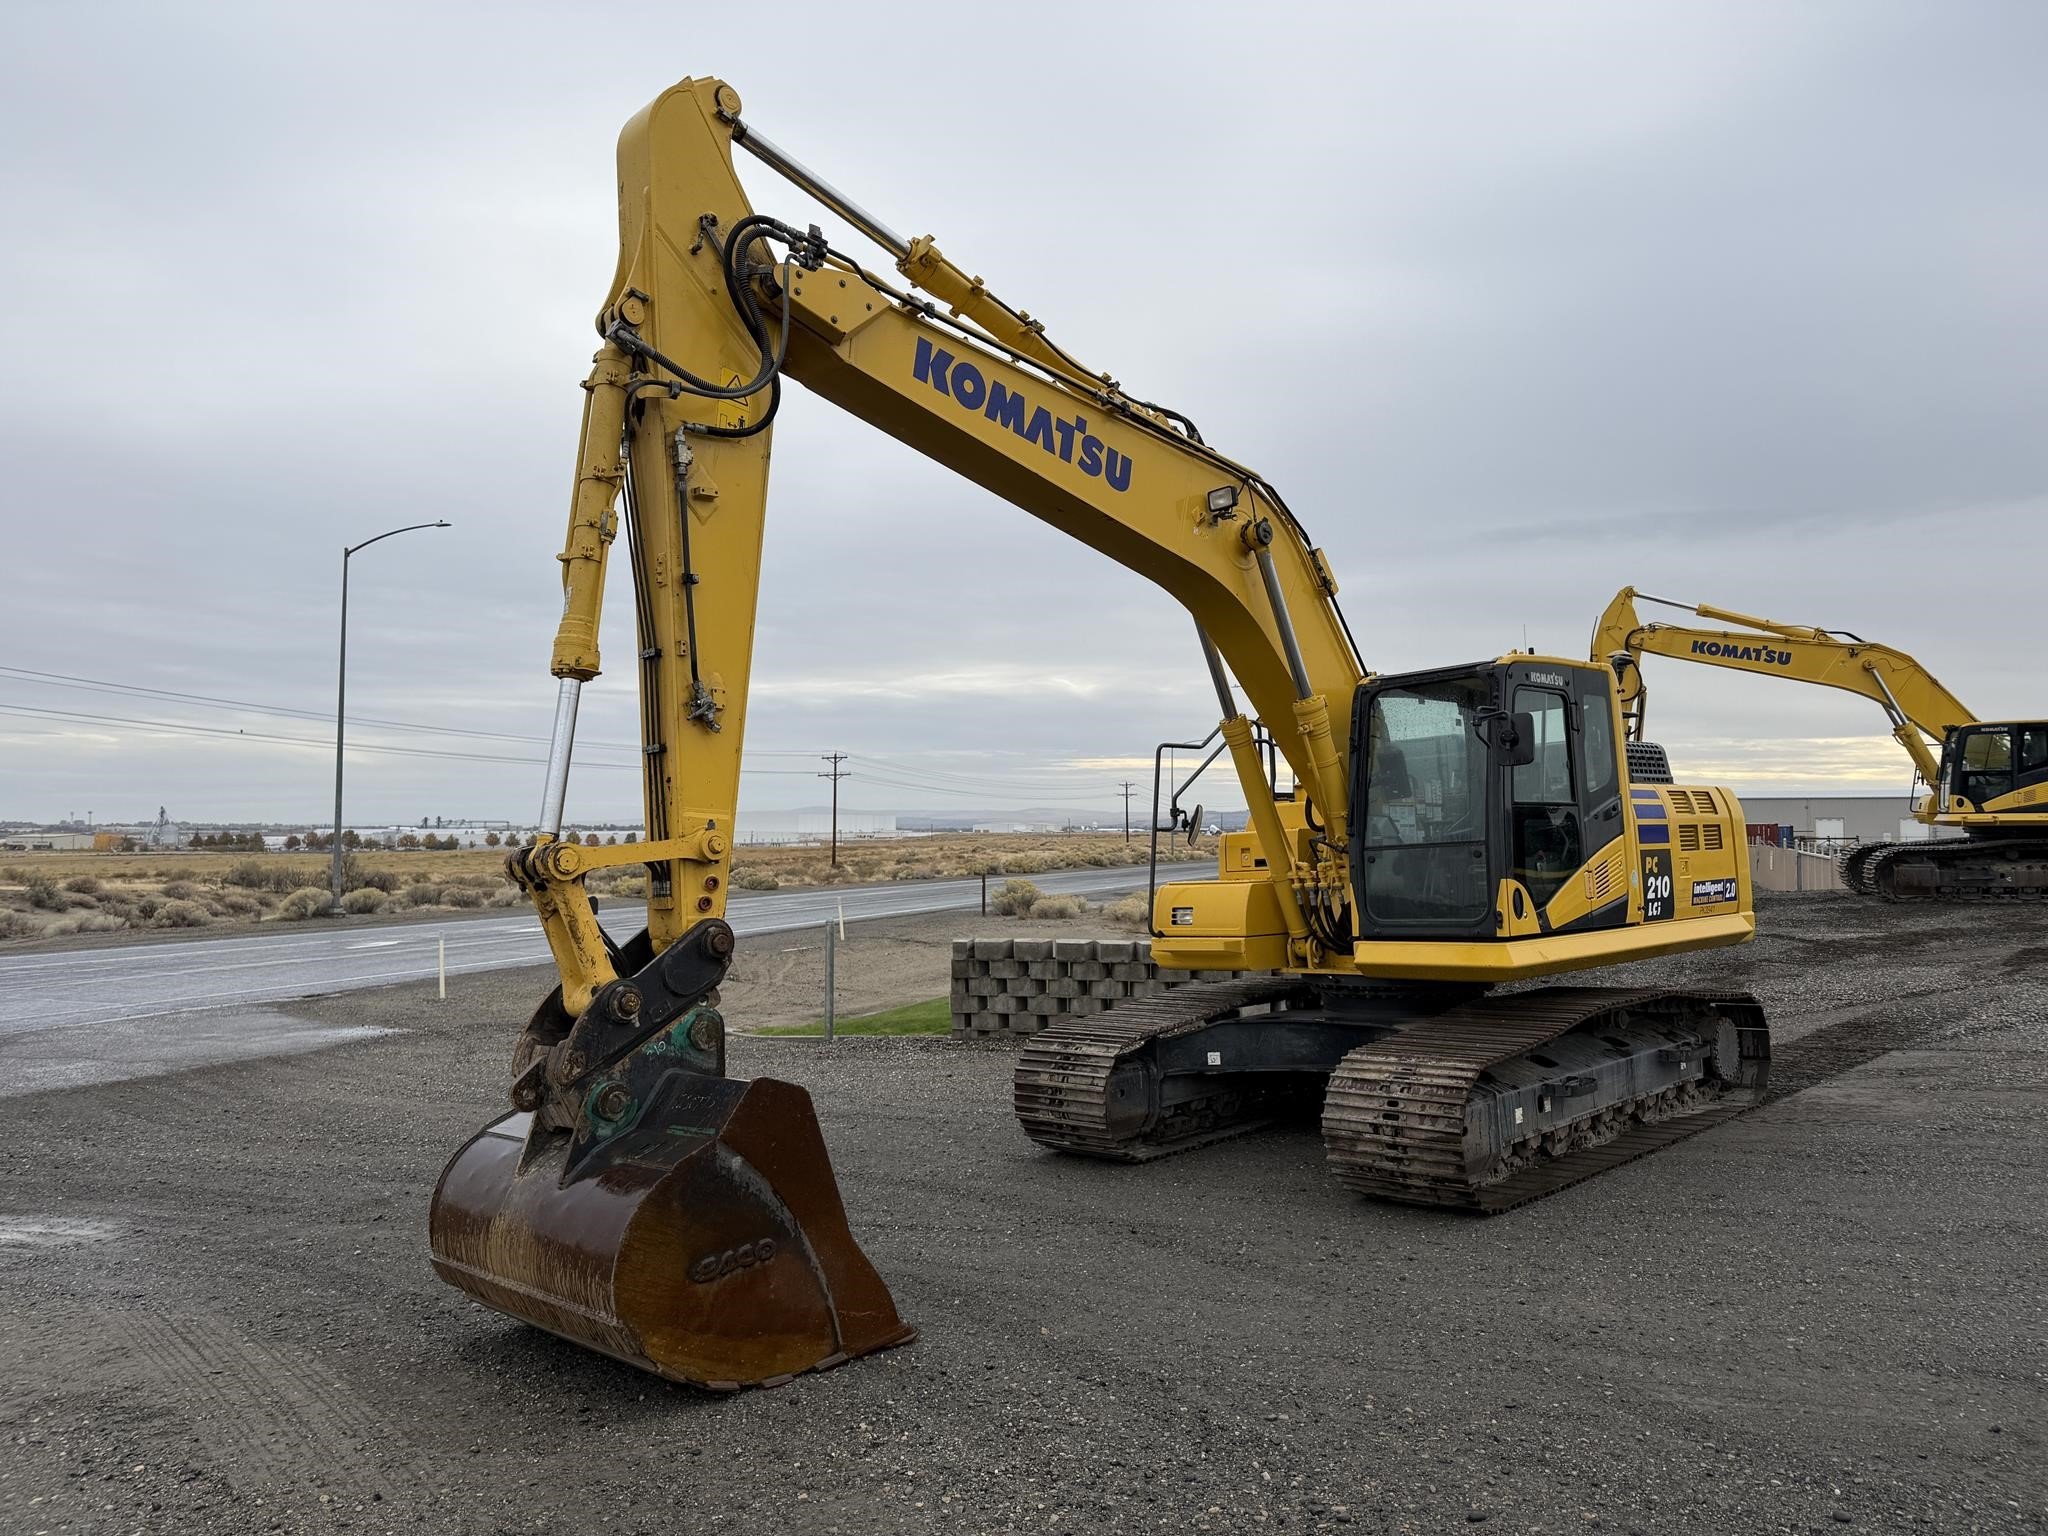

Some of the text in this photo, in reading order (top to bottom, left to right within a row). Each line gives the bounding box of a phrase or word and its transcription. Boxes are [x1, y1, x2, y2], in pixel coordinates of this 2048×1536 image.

[913, 335, 1133, 492] KOMATSU
[1691, 640, 1792, 665] KOMATSU
[1530, 671, 1563, 686] KOMATSU
[1645, 856, 1658, 873] PC
[1647, 875, 1670, 899] 210
[1725, 882, 1735, 898] 2.0
